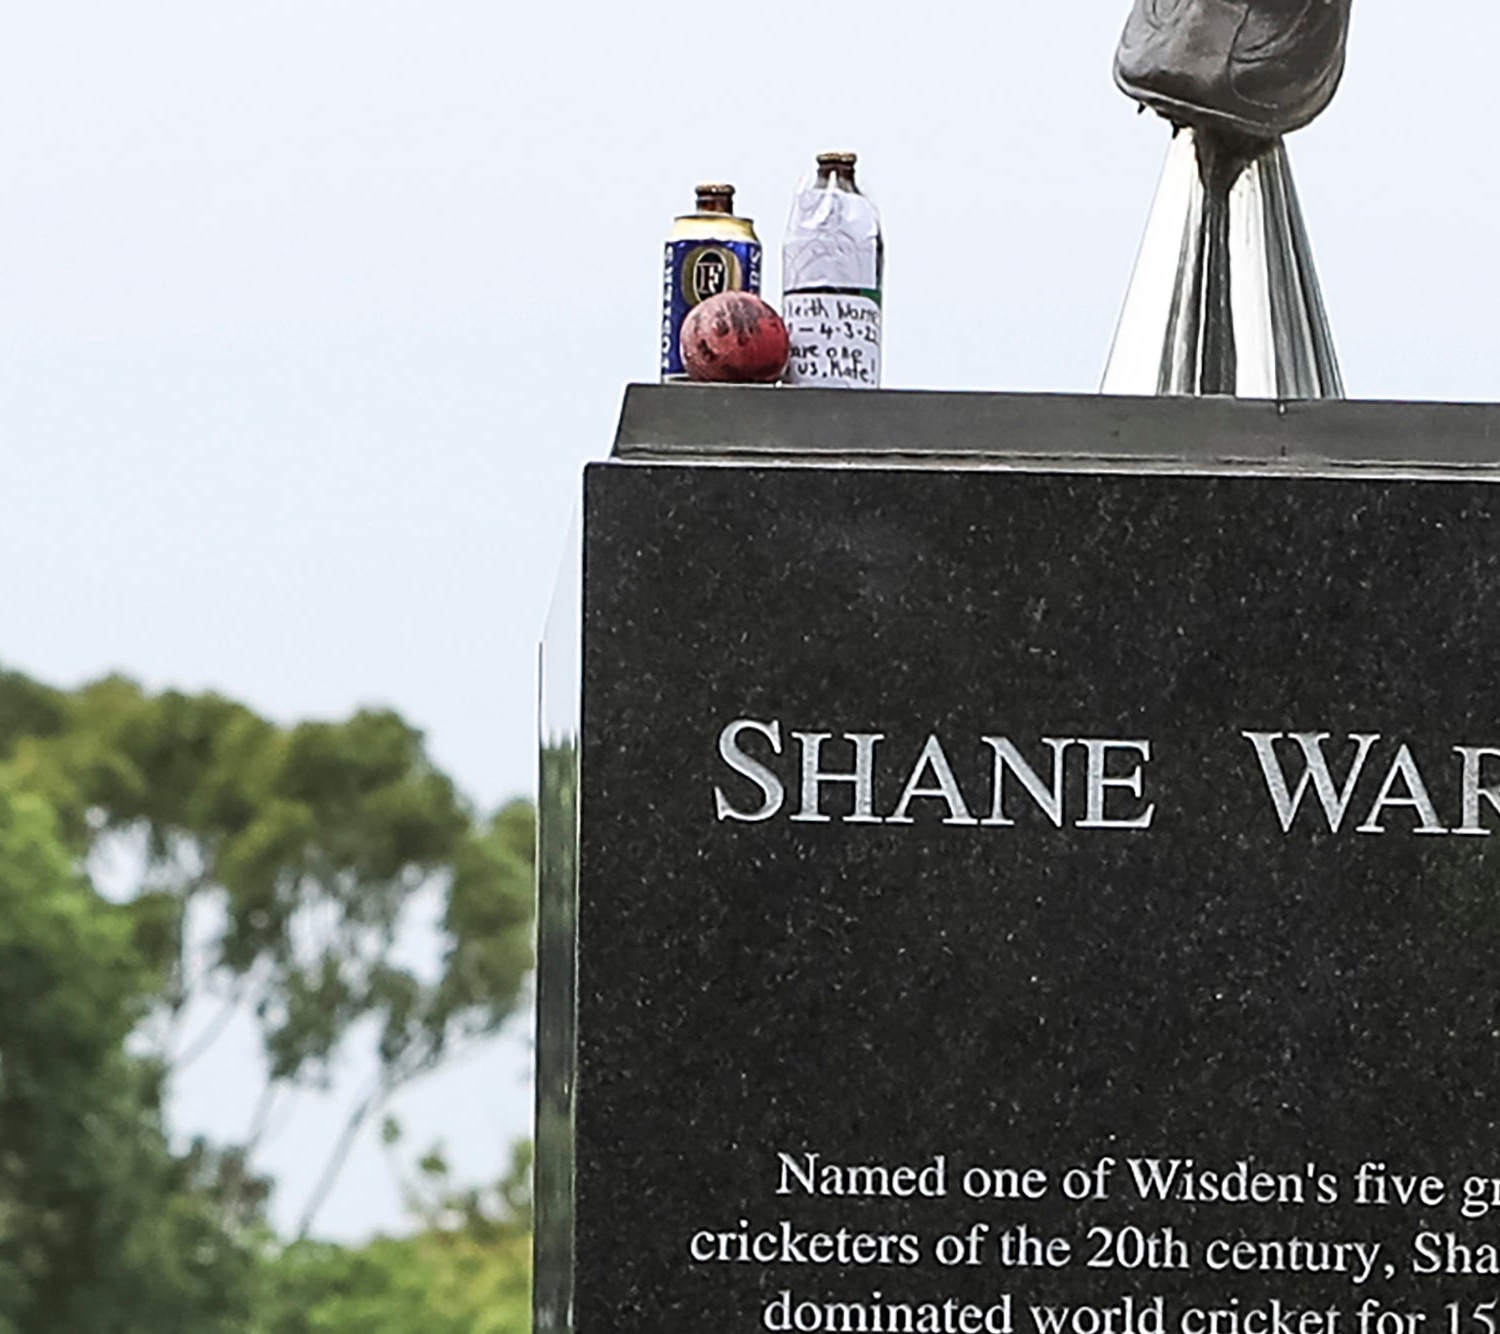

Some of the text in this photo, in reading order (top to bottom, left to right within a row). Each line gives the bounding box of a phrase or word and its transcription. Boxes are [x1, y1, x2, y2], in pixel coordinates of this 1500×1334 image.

[713, 719, 1155, 829] SHANE
[774, 1151, 948, 1197] Named
[962, 1167, 1048, 1199] one
[1062, 1156, 1117, 1200] of
[1126, 1157, 1338, 1204] Wisden's
[1353, 1161, 1446, 1206] five
[690, 1219, 920, 1265] cricketers
[935, 1222, 990, 1266] of
[1000, 1223, 1072, 1268] the
[1086, 1225, 1190, 1269] 20th
[1205, 1236, 1395, 1284] century,
